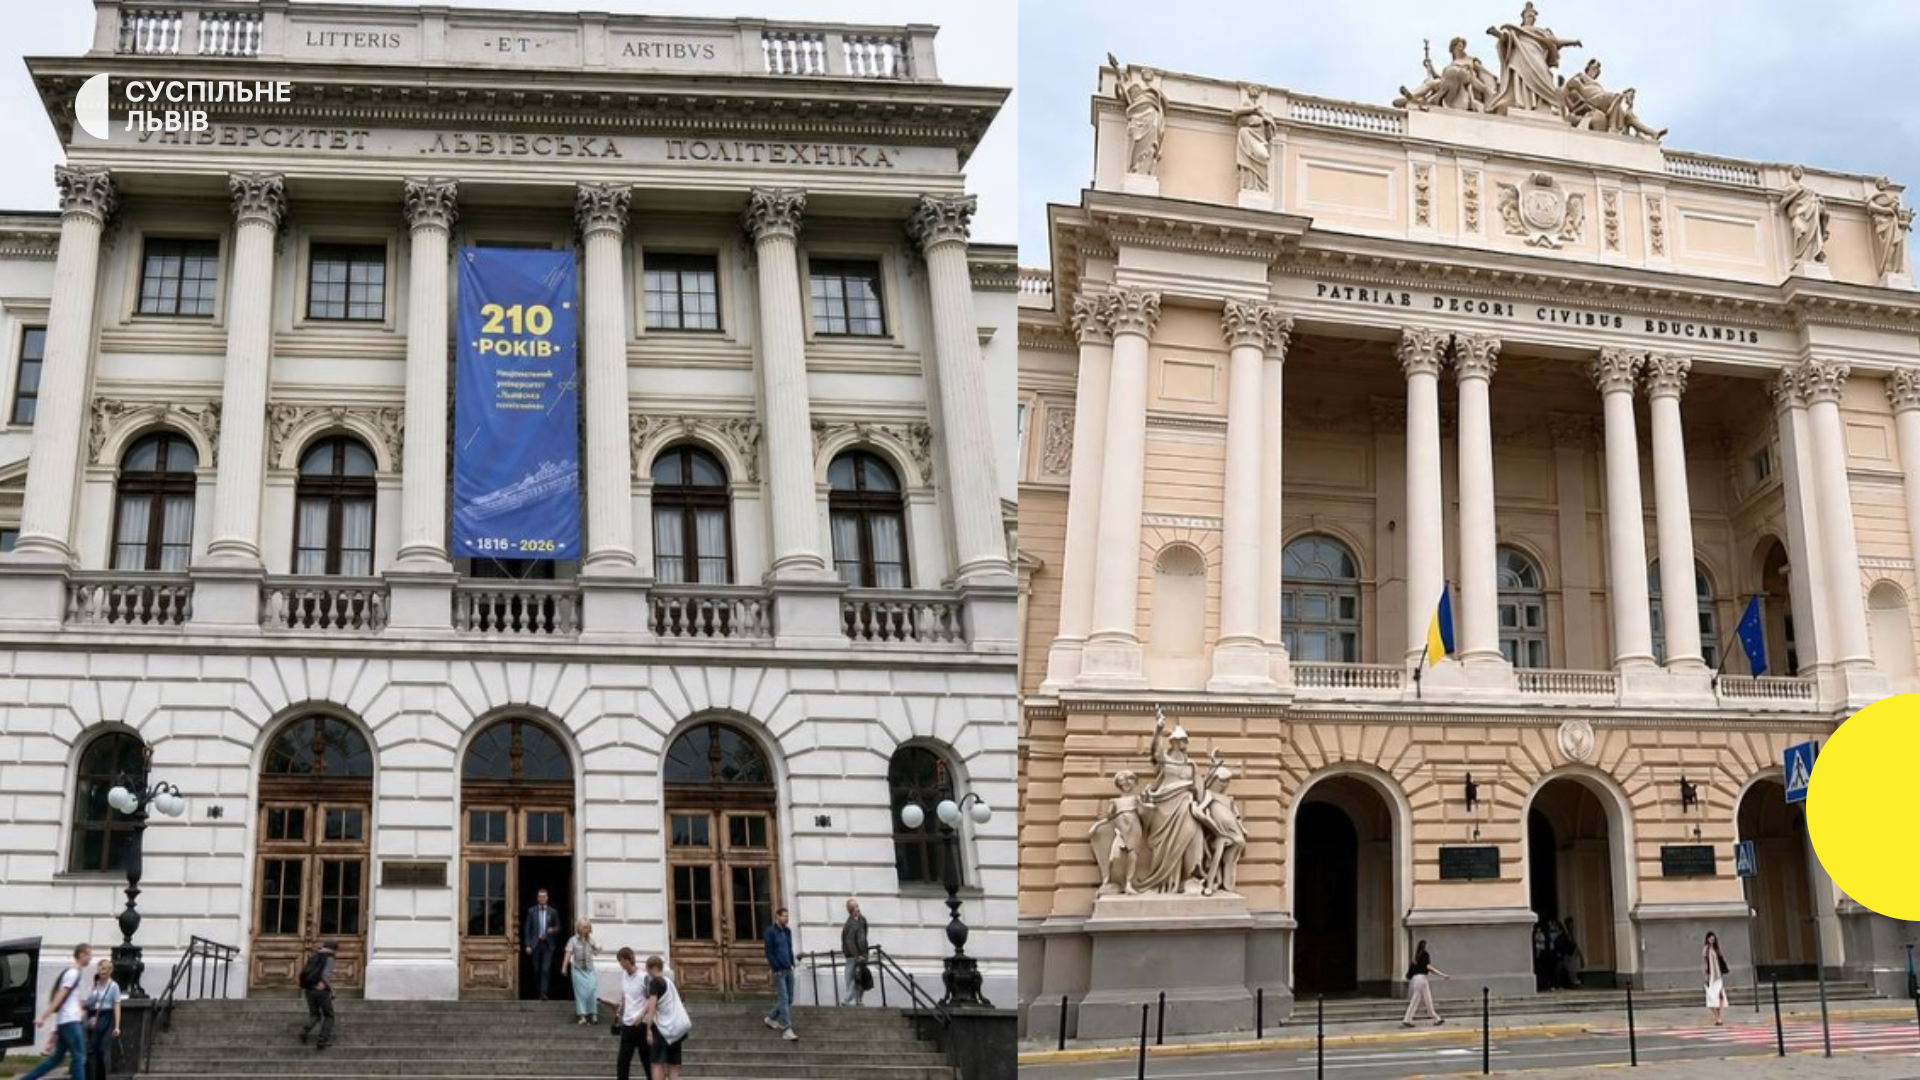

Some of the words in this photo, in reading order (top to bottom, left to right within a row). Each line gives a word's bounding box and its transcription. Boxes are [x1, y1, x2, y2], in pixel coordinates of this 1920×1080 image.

[306, 31, 400, 48] LITTERIS
[622, 42, 715, 60] ARTIBVS
[480, 303, 553, 335] 210
[1317, 283, 1411, 306] PATRIAE
[1433, 296, 1514, 317] DECORI
[1536, 307, 1623, 329] CIVIBUS
[1645, 319, 1759, 344] EDUCANDIS
[477, 538, 509, 550] 1816
[520, 539, 555, 551] 2026
